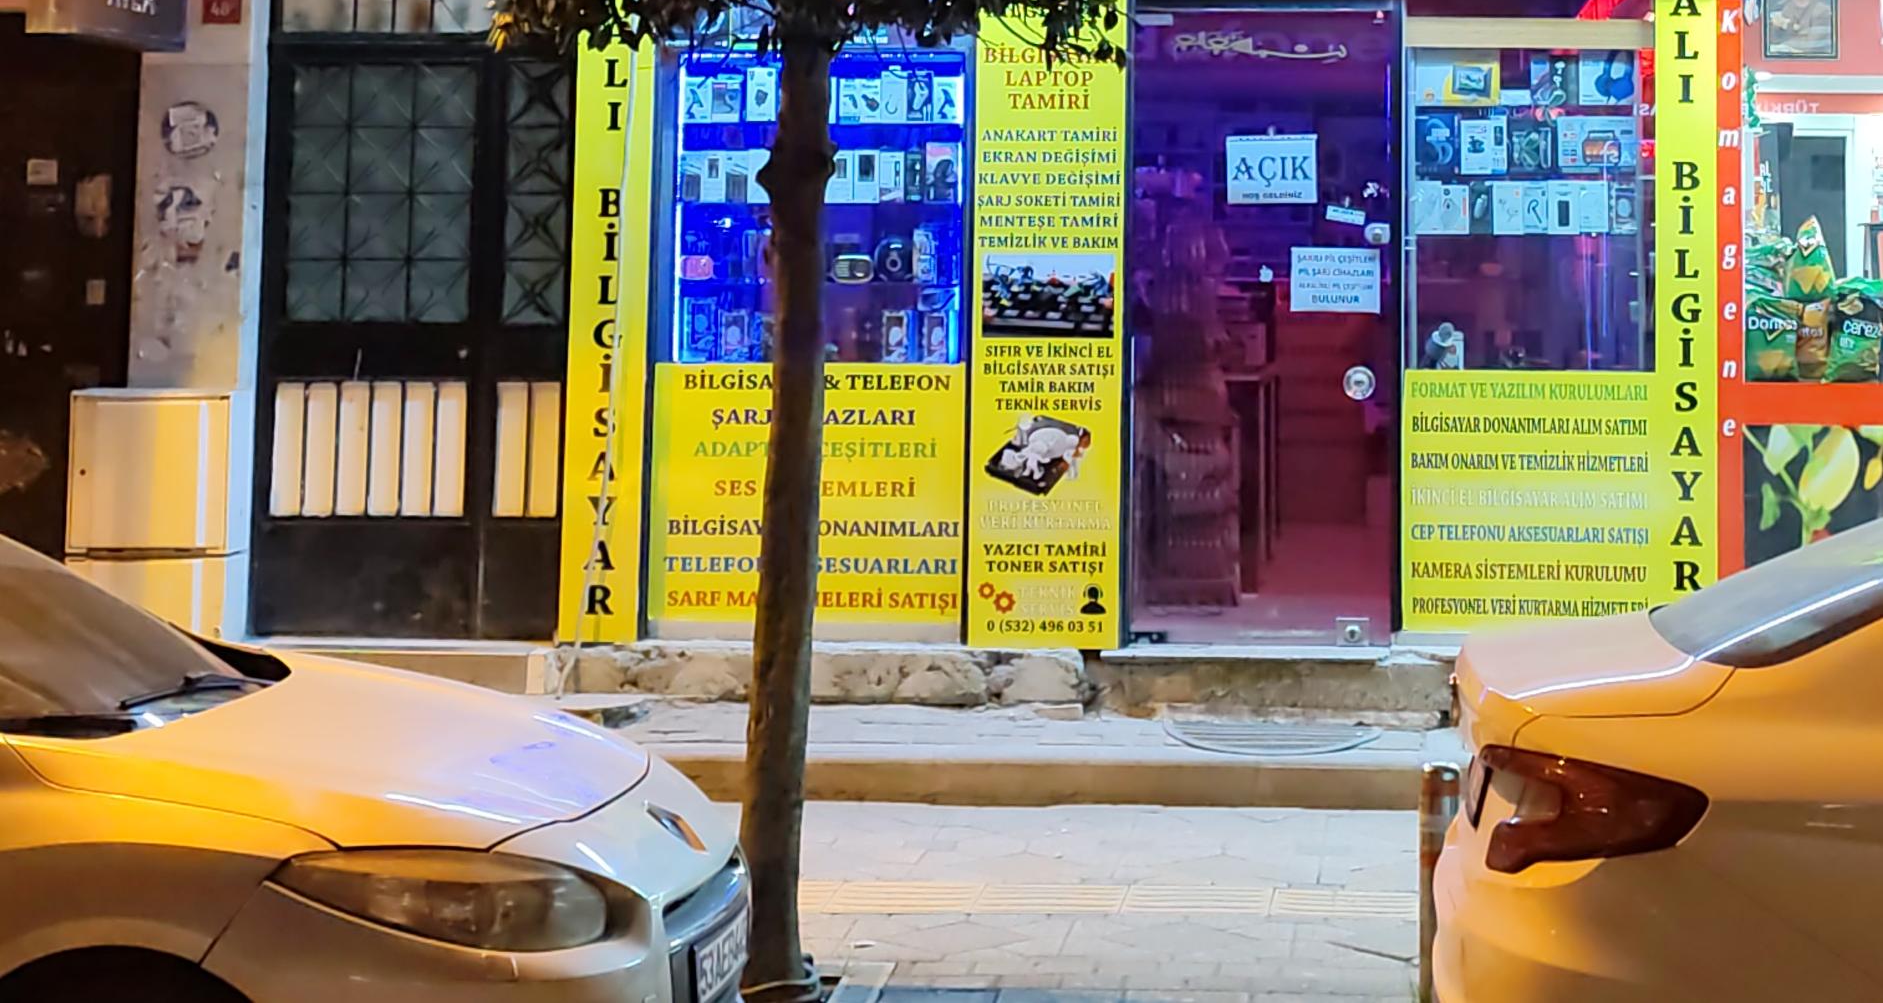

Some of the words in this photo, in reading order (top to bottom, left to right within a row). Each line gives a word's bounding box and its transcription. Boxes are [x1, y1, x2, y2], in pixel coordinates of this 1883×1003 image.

[1005, 71, 1093, 87] LAPTOP
[1008, 89, 1090, 109] TAMİRİ
[982, 129, 1057, 142] ANAKART
[1060, 126, 1118, 142] TAMİRİ
[983, 151, 1037, 163] EKRAN
[1042, 148, 1117, 166] DEĞİŞİMİ
[978, 173, 1040, 185] KLAVYE
[1046, 170, 1120, 188] DEĞİŞİMİ
[1232, 156, 1312, 187] AÇIK
[977, 195, 1012, 210] ŞARJ
[1015, 192, 1066, 207] SOKETİ
[1070, 192, 1120, 207] TAMİRİ
[980, 216, 1055, 231] MENTEŞE
[1059, 213, 1119, 228] TAMİRİ
[1717, 9, 1740, 438] Komagene
[978, 233, 1047, 248] TEMİZLİK
[1051, 236, 1070, 248] VE
[1073, 236, 1118, 248] BAKIM
[1312, 295, 1359, 303] BULUNUR
[985, 346, 1021, 358] SIFIR
[1026, 346, 1043, 358] VE
[1048, 342, 1093, 358] İKİNCİ
[1097, 346, 1113, 358] EL
[983, 361, 1066, 375] BİLGİSAYAR
[1070, 364, 1115, 379] SATIŞI
[1669, 162, 1703, 591] BİLGİSAYAR
[684, 369, 773, 390] BİLGİSA
[846, 374, 950, 391] TELEFON
[999, 377, 1044, 393] TAMİR
[1049, 381, 1094, 393] BAKIM
[1411, 382, 1466, 398] FORMAT
[1470, 383, 1487, 398] VE
[1490, 383, 1545, 399] YAZILIM
[1549, 383, 1648, 401] KURULUMLARI
[995, 395, 1050, 410] TEKNİK
[1052, 395, 1102, 411] SERVİS
[711, 409, 773, 430] ŞARJ
[823, 409, 915, 425] AZLARI
[1412, 411, 1480, 433] BİLGİSAYAR
[1483, 417, 1569, 434] DONANIMLARI
[1572, 418, 1602, 435] ALIM
[1605, 419, 1647, 435] SATIMI
[694, 441, 769, 457] ADAPT
[1411, 453, 1448, 469] BAKIM
[1451, 453, 1498, 470] ONARIM
[1501, 454, 1516, 470] VE
[1518, 449, 1575, 471] TEMİZLİK
[1577, 449, 1648, 472] HİZMETLERİ
[714, 480, 757, 496] SES
[822, 477, 916, 498] EMLERİ
[988, 499, 1103, 513] PROFESYONEL
[1459, 489, 1473, 506] EL
[668, 514, 764, 535] BİLGİSAY
[818, 520, 959, 537] ONANIMLARI
[980, 511, 1017, 529] VERİ
[1411, 524, 1434, 540] CEP
[1438, 524, 1506, 541] TELEFONU
[1508, 526, 1605, 543] AKSESUARLARI
[1608, 527, 1649, 548] SATIŞI
[983, 544, 1039, 556] YAZICI
[1045, 541, 1107, 557] TAMİRİ
[985, 561, 1043, 573] TONER
[1049, 561, 1103, 577] SATIŞI
[1411, 562, 1473, 578] KAMERA
[1475, 558, 1560, 580] SİSTEMLERİ
[1564, 564, 1647, 582] KURULUMU
[667, 591, 720, 606] SARF
[888, 592, 957, 614] SATIŞI
[1412, 597, 1489, 614] PROFESYONEL
[1491, 593, 1516, 615] VERİ
[1519, 599, 1579, 616] KURTARMA
[987, 620, 995, 632] 0
[1000, 619, 1035, 633] (532)
[1039, 620, 1064, 633] 496
[1067, 620, 1084, 633] 03
[1088, 620, 1103, 633] 51
